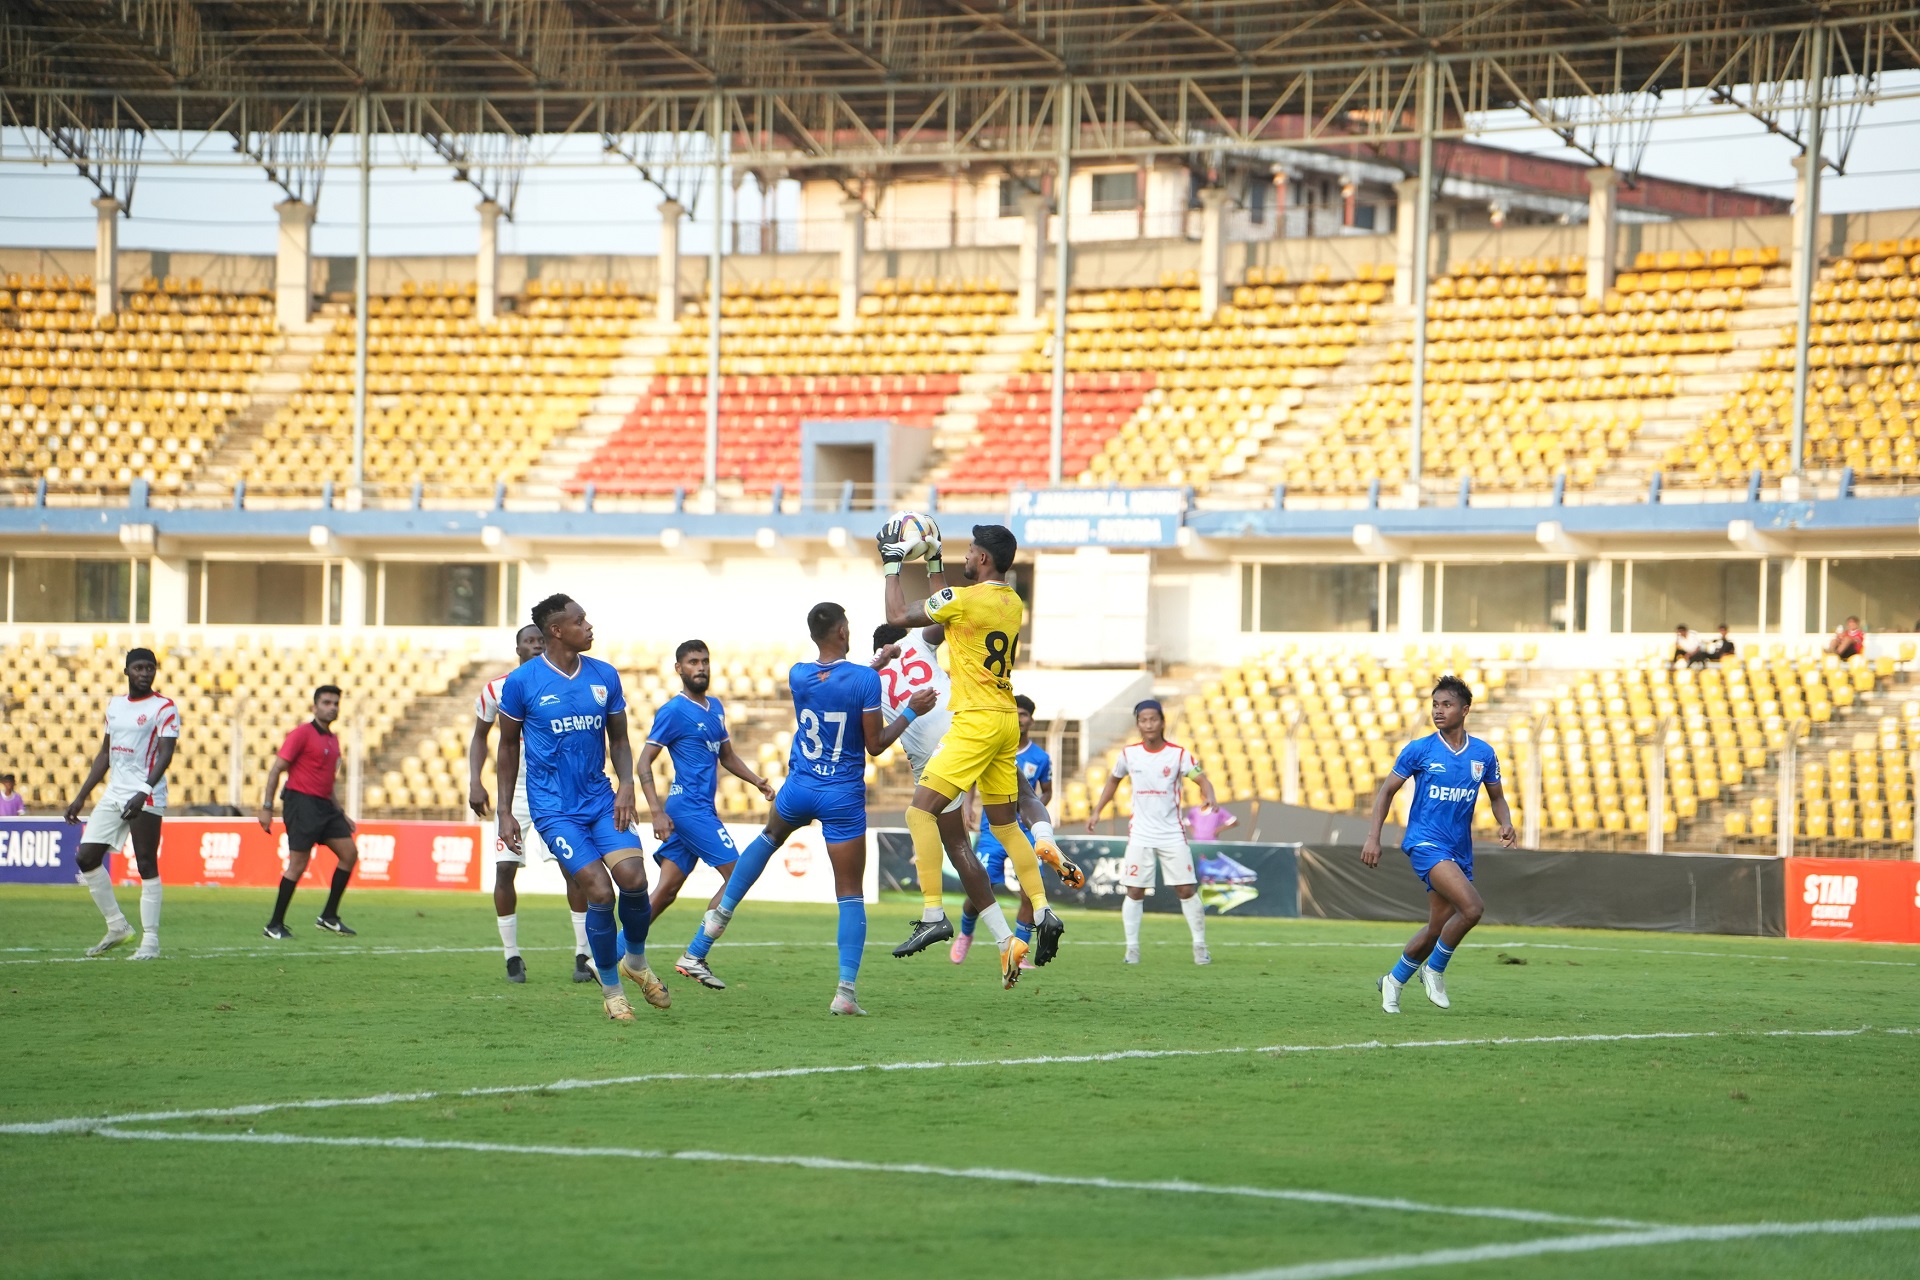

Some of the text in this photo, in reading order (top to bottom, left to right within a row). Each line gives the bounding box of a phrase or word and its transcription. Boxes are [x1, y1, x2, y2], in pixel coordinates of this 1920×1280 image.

[879, 647, 934, 711] 25
[550, 714, 602, 734] DEMPO
[799, 708, 848, 762] 37
[1429, 785, 1475, 802] DEMPO
[199, 832, 241, 859] STAR
[356, 834, 395, 861] STAR
[432, 836, 473, 863] STAR
[555, 836, 574, 860] 3
[716, 828, 734, 849] 5
[1803, 874, 1858, 905] STAR
